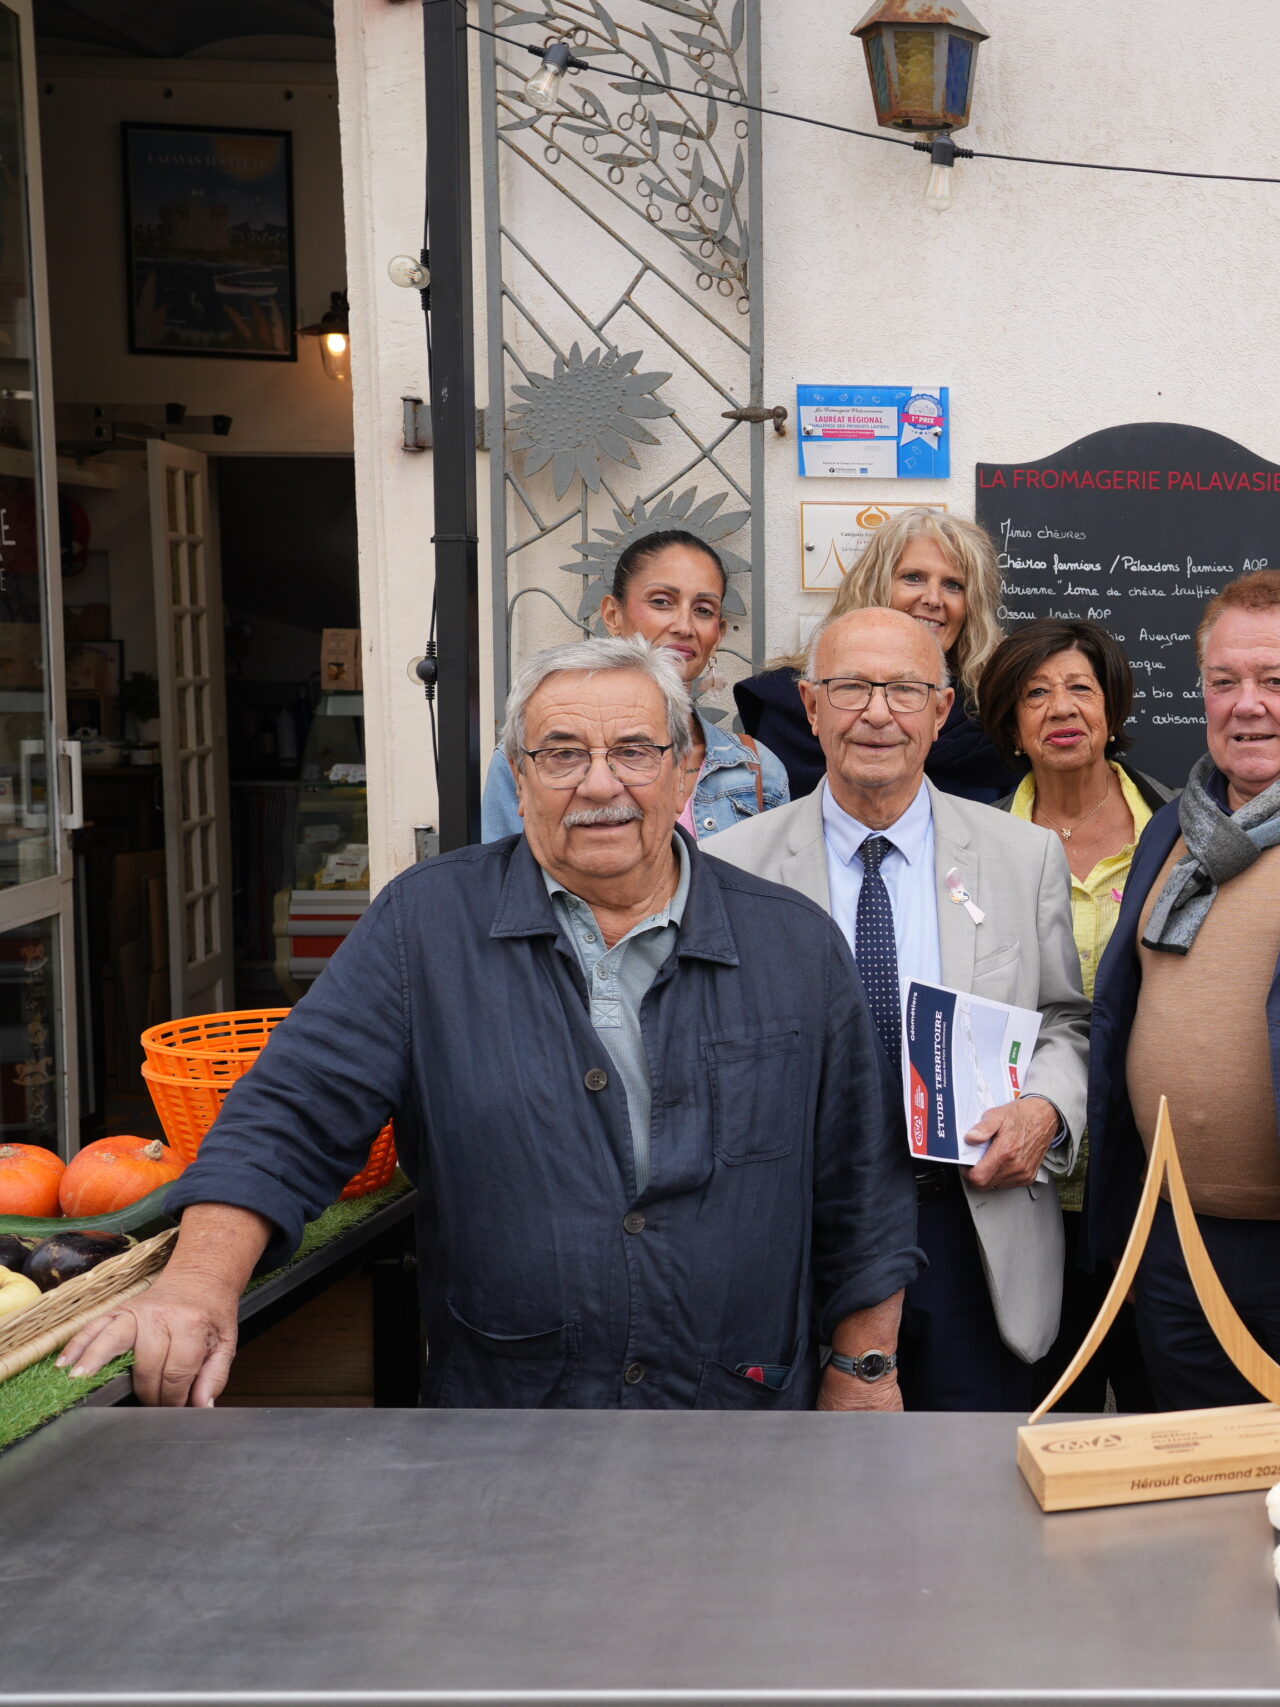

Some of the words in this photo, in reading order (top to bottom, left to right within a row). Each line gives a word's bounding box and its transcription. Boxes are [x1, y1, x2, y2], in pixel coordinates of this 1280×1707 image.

[815, 415, 845, 423] LAURÉAT
[848, 415, 883, 424] RÉGIONAL
[979, 470, 1006, 488] LA
[1013, 469, 1160, 490] FROMAGERIE
[1243, 558, 1268, 572] AOP
[1064, 581, 1099, 596] tome
[1106, 585, 1122, 596] de
[997, 605, 1038, 620] Ossau
[1087, 607, 1112, 619] AOP
[1139, 628, 1192, 649] Aveyron
[1152, 686, 1174, 698] bio
[934, 1010, 943, 1091] TERRITOIRE
[936, 1092, 945, 1138] ÉTUDE
[1131, 1475, 1179, 1491] Hérault
[1183, 1467, 1252, 1486] Gourmand
